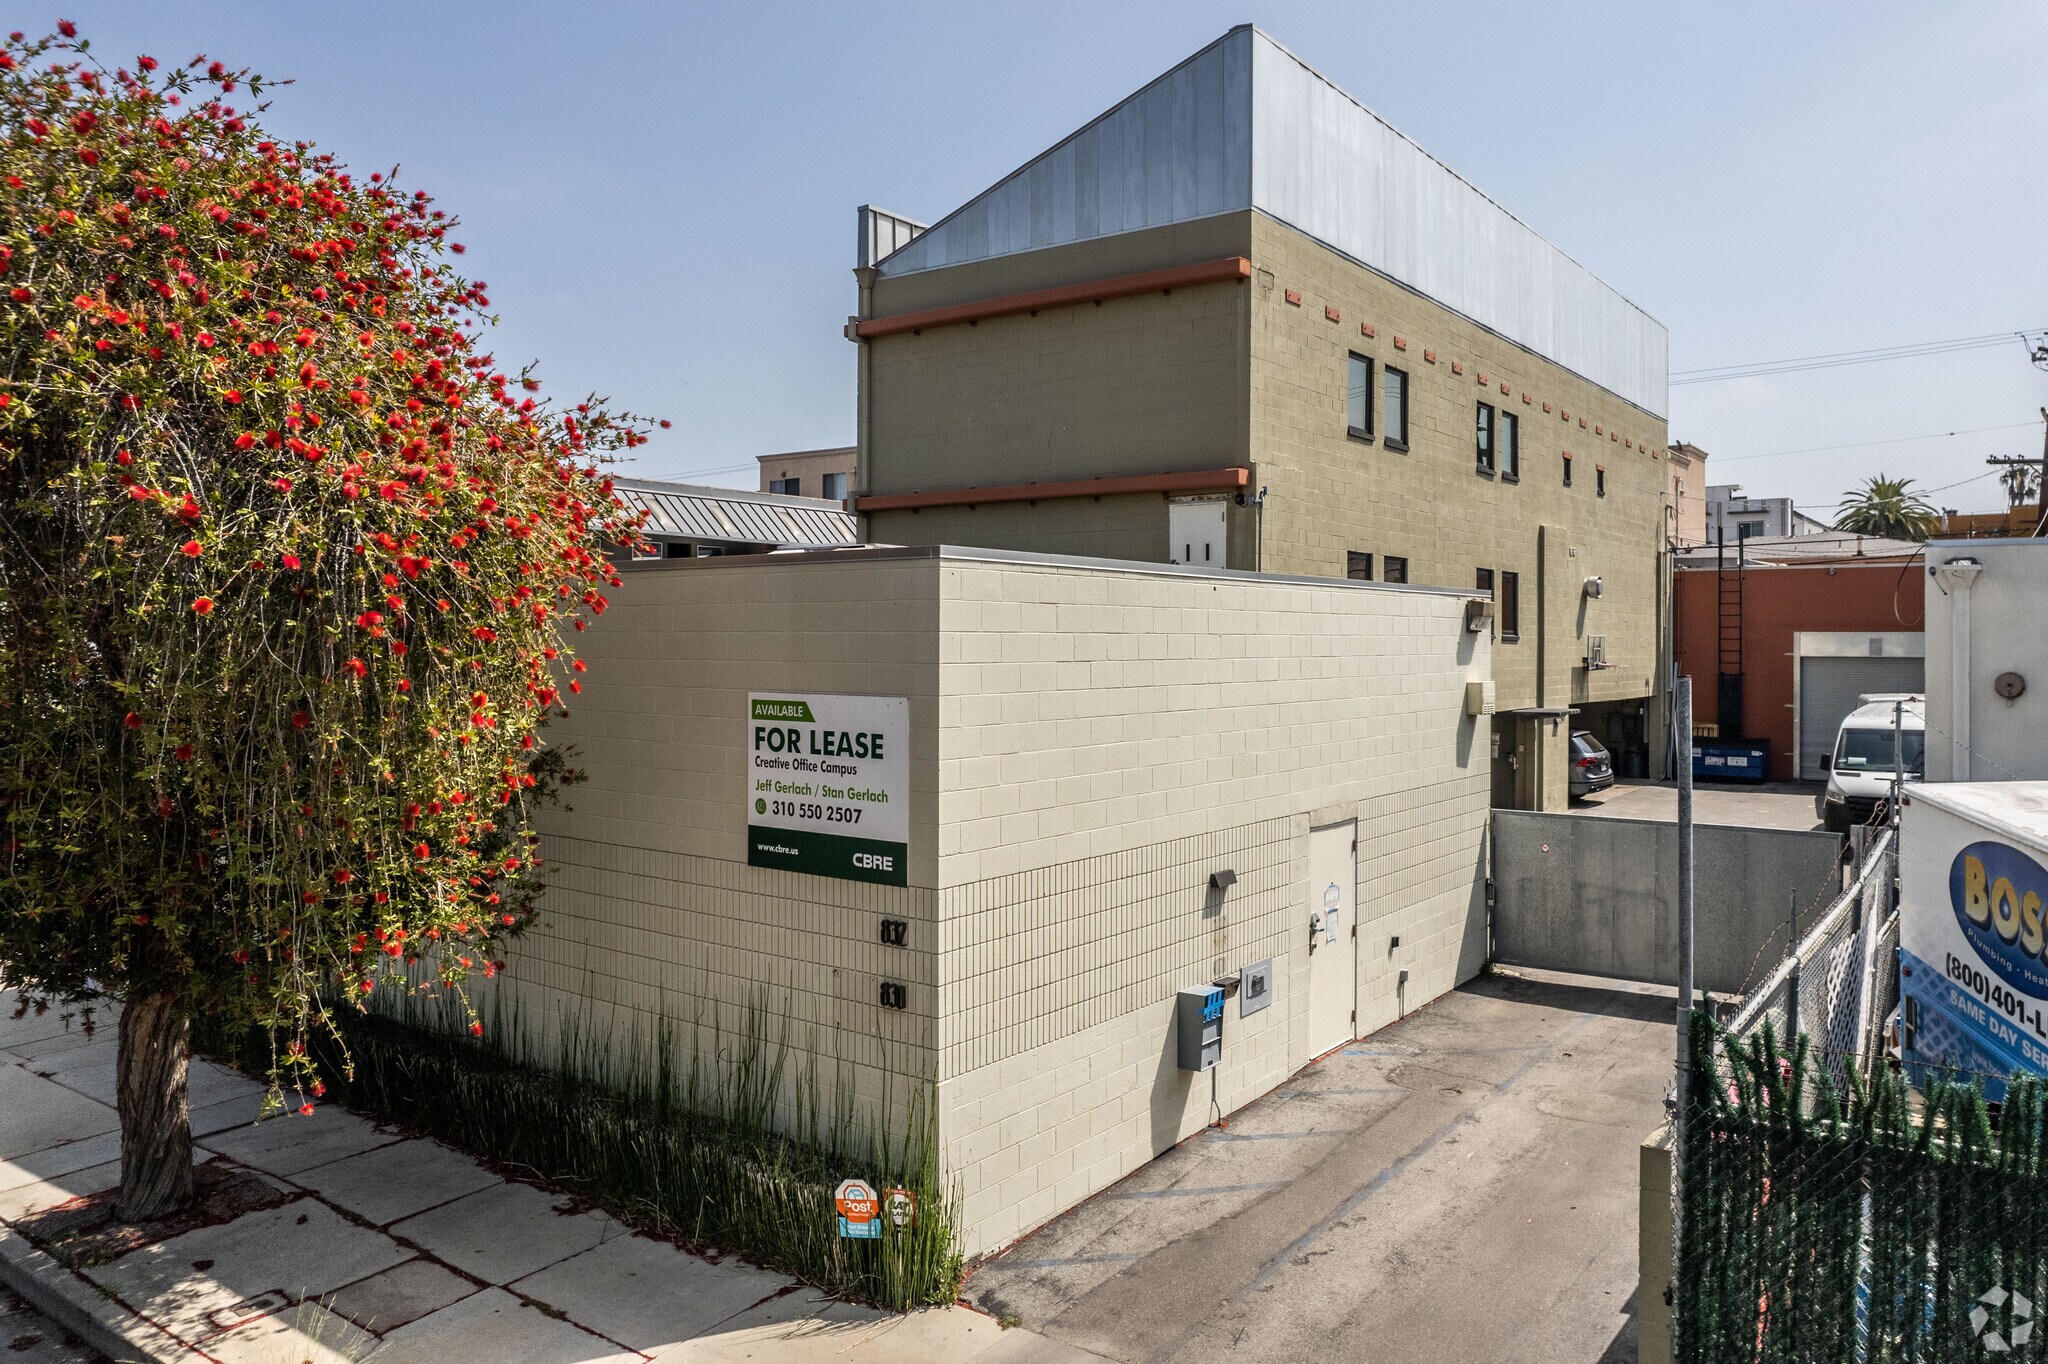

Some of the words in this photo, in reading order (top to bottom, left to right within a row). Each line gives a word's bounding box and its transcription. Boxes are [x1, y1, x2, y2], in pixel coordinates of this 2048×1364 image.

[755, 704, 803, 717] AVAILABLE
[755, 726, 801, 754] FOR
[810, 730, 884, 760] LEASE
[755, 755, 790, 770] Creative
[792, 758, 818, 772] Office
[820, 760, 857, 777] Campus
[755, 779, 772, 792] Jeff
[774, 780, 812, 796] Gerlach
[814, 784, 819, 797] /
[821, 784, 844, 799] Stan
[847, 787, 888, 803] Gerlach
[772, 800, 795, 817] 310
[799, 803, 822, 820] 550
[826, 806, 862, 824] 2507
[757, 843, 799, 855] www.cbre.us
[852, 852, 893, 871] CBRE
[1965, 853, 2048, 960] BOS
[1968, 927, 2012, 972] Plumbing
[1946, 952, 2048, 1039] (800)401-L
[1950, 989, 1986, 1026] SAME
[1989, 1016, 2018, 1047] DAY
